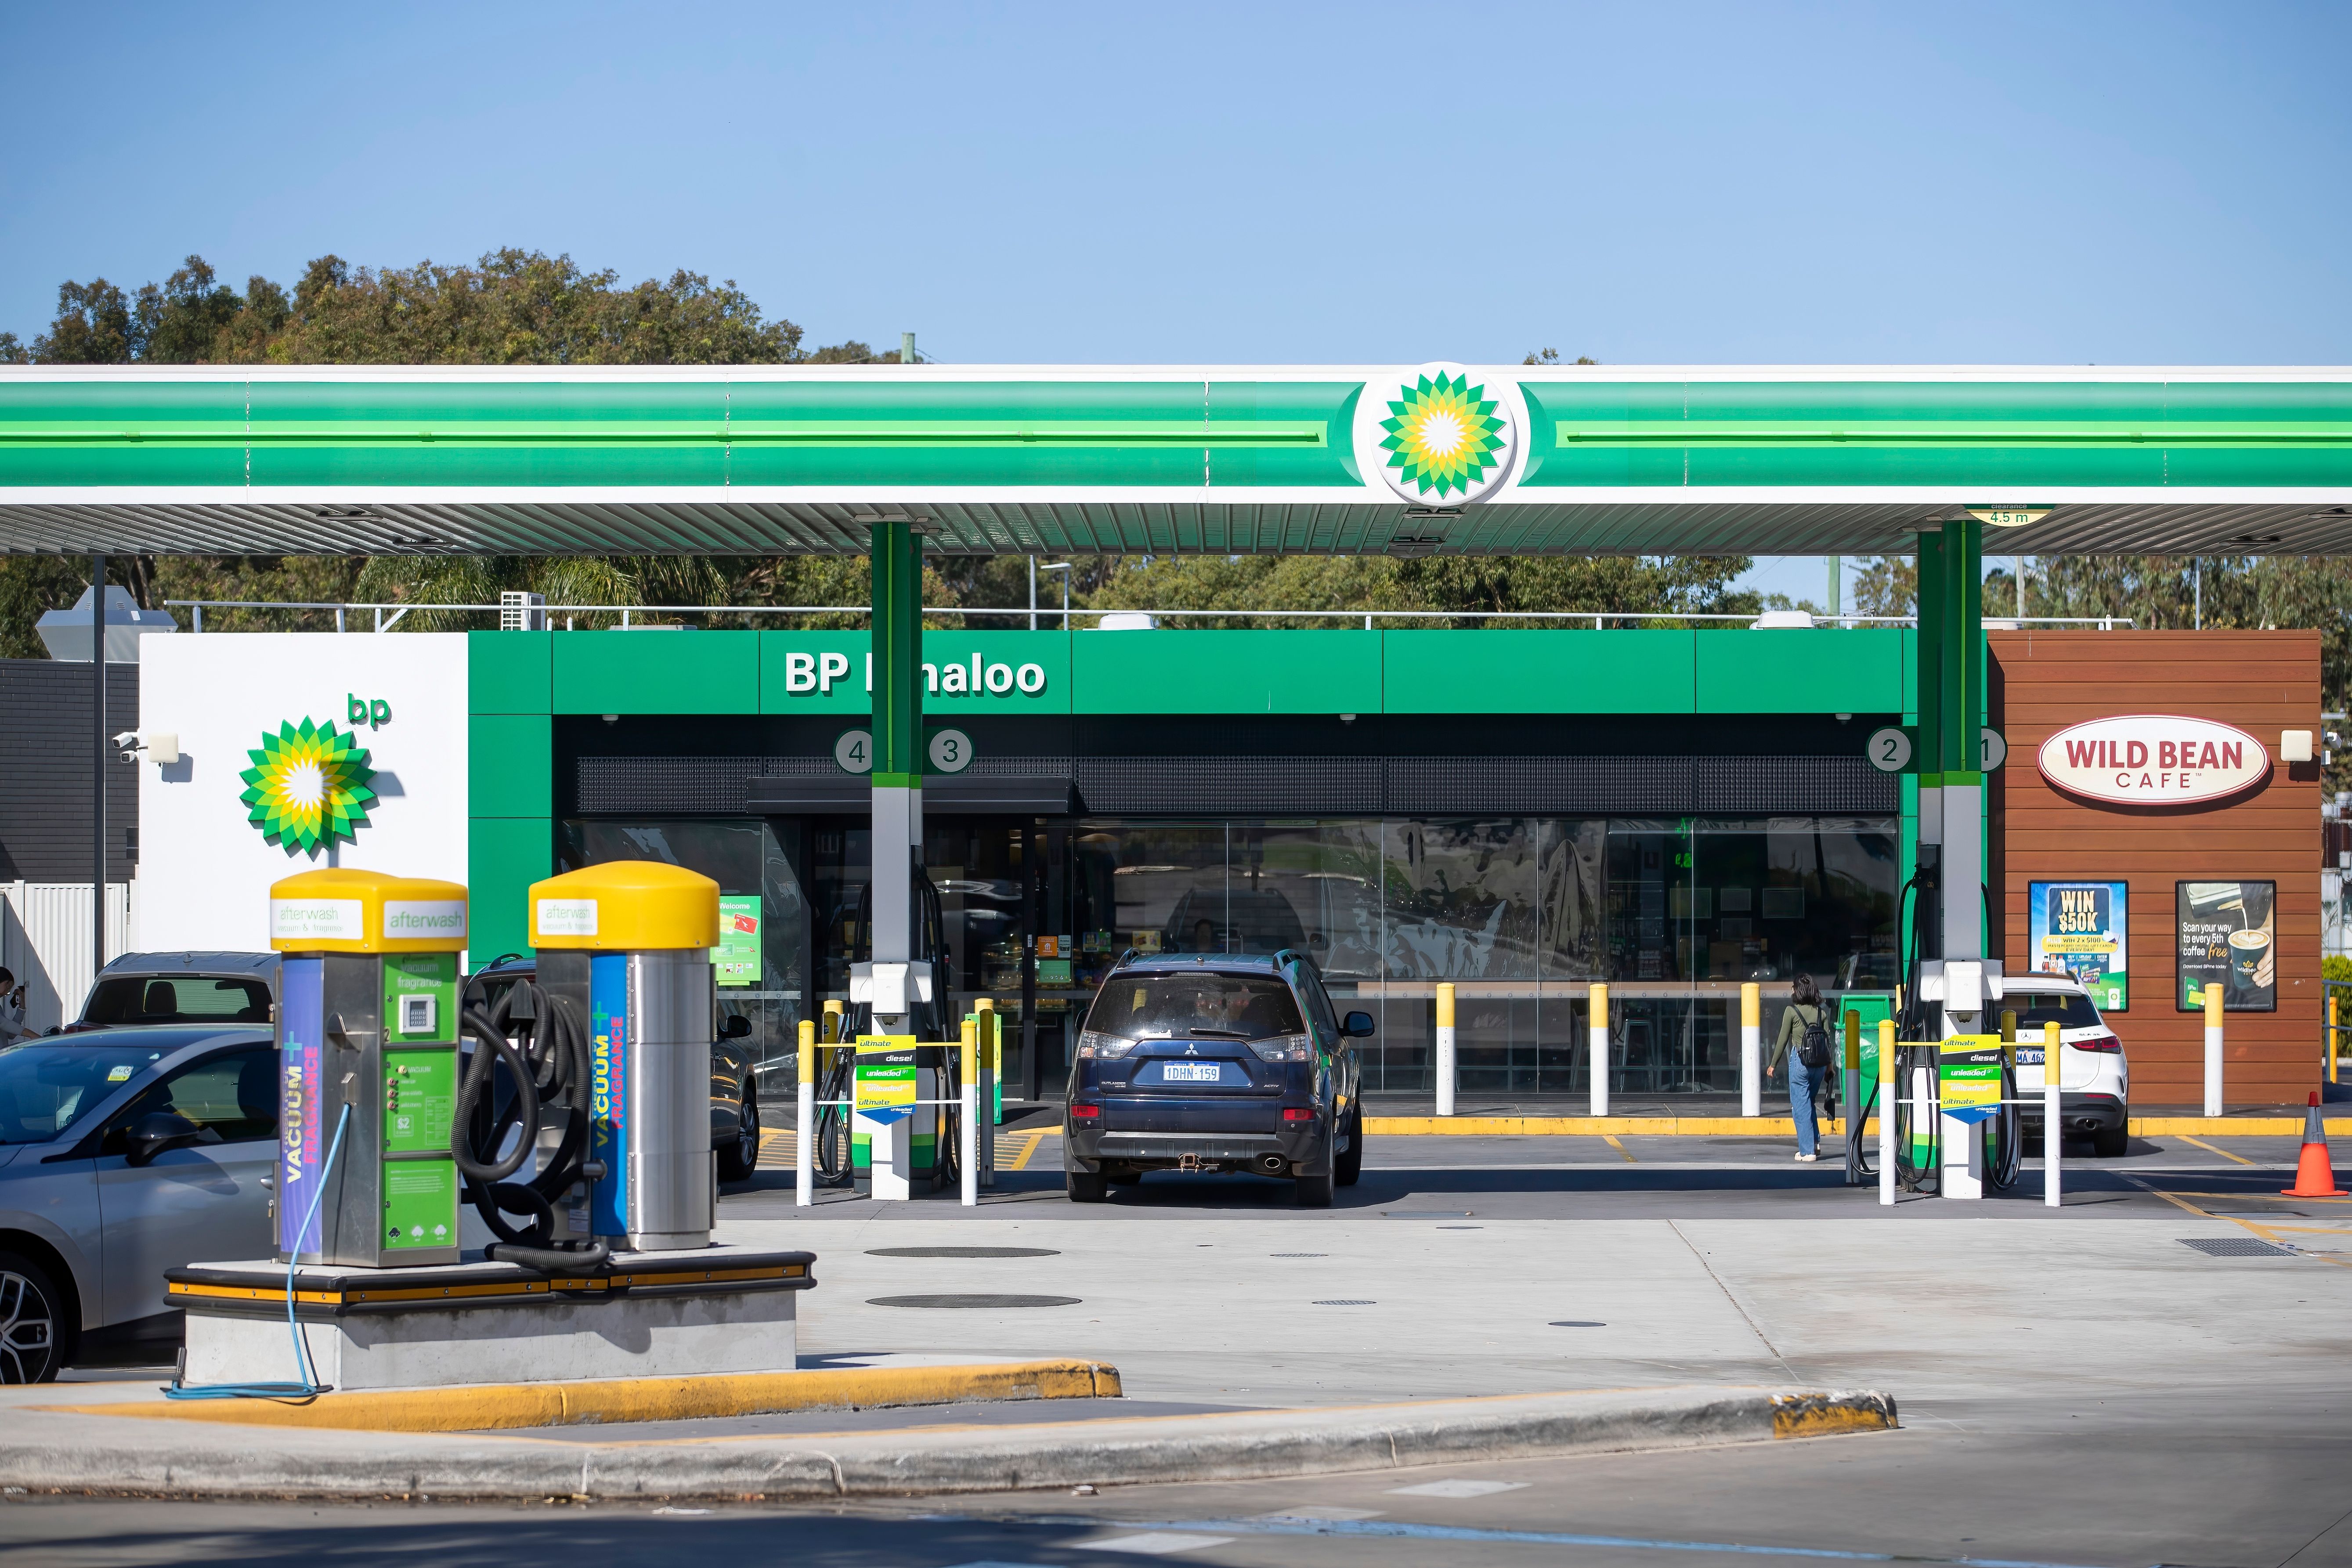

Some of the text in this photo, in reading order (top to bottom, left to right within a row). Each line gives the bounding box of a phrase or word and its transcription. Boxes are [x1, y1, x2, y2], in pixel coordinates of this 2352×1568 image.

[1991, 512, 2028, 522] 4.5 m
[786, 652, 1045, 693] BP Inaloo
[348, 693, 390, 726] bp
[848, 740, 866, 763] 4
[942, 739, 959, 762] 3
[1882, 738, 1897, 762] 2
[1981, 738, 1989, 761] 1
[2066, 740, 2242, 769] WILD BEAN
[2116, 773, 2190, 788] CAFE
[546, 905, 590, 918] afterwash
[2060, 891, 2094, 912] WIN
[281, 906, 338, 920] afterwash
[390, 911, 462, 928] afterwash
[2058, 912, 2098, 934] $50K
[2183, 922, 2232, 934] Scan your way
[2183, 933, 2223, 945] to every 5th
[2183, 943, 2228, 961] coffee free
[401, 963, 439, 972] vacuum
[397, 975, 442, 990] fragrance
[611, 1016, 624, 1129] FRAGRANCE
[596, 1035, 609, 1148] VACUUM
[303, 1046, 318, 1163] FRAGRANCE
[287, 1066, 302, 1184] VACUUM
[397, 1117, 410, 1130] $2
